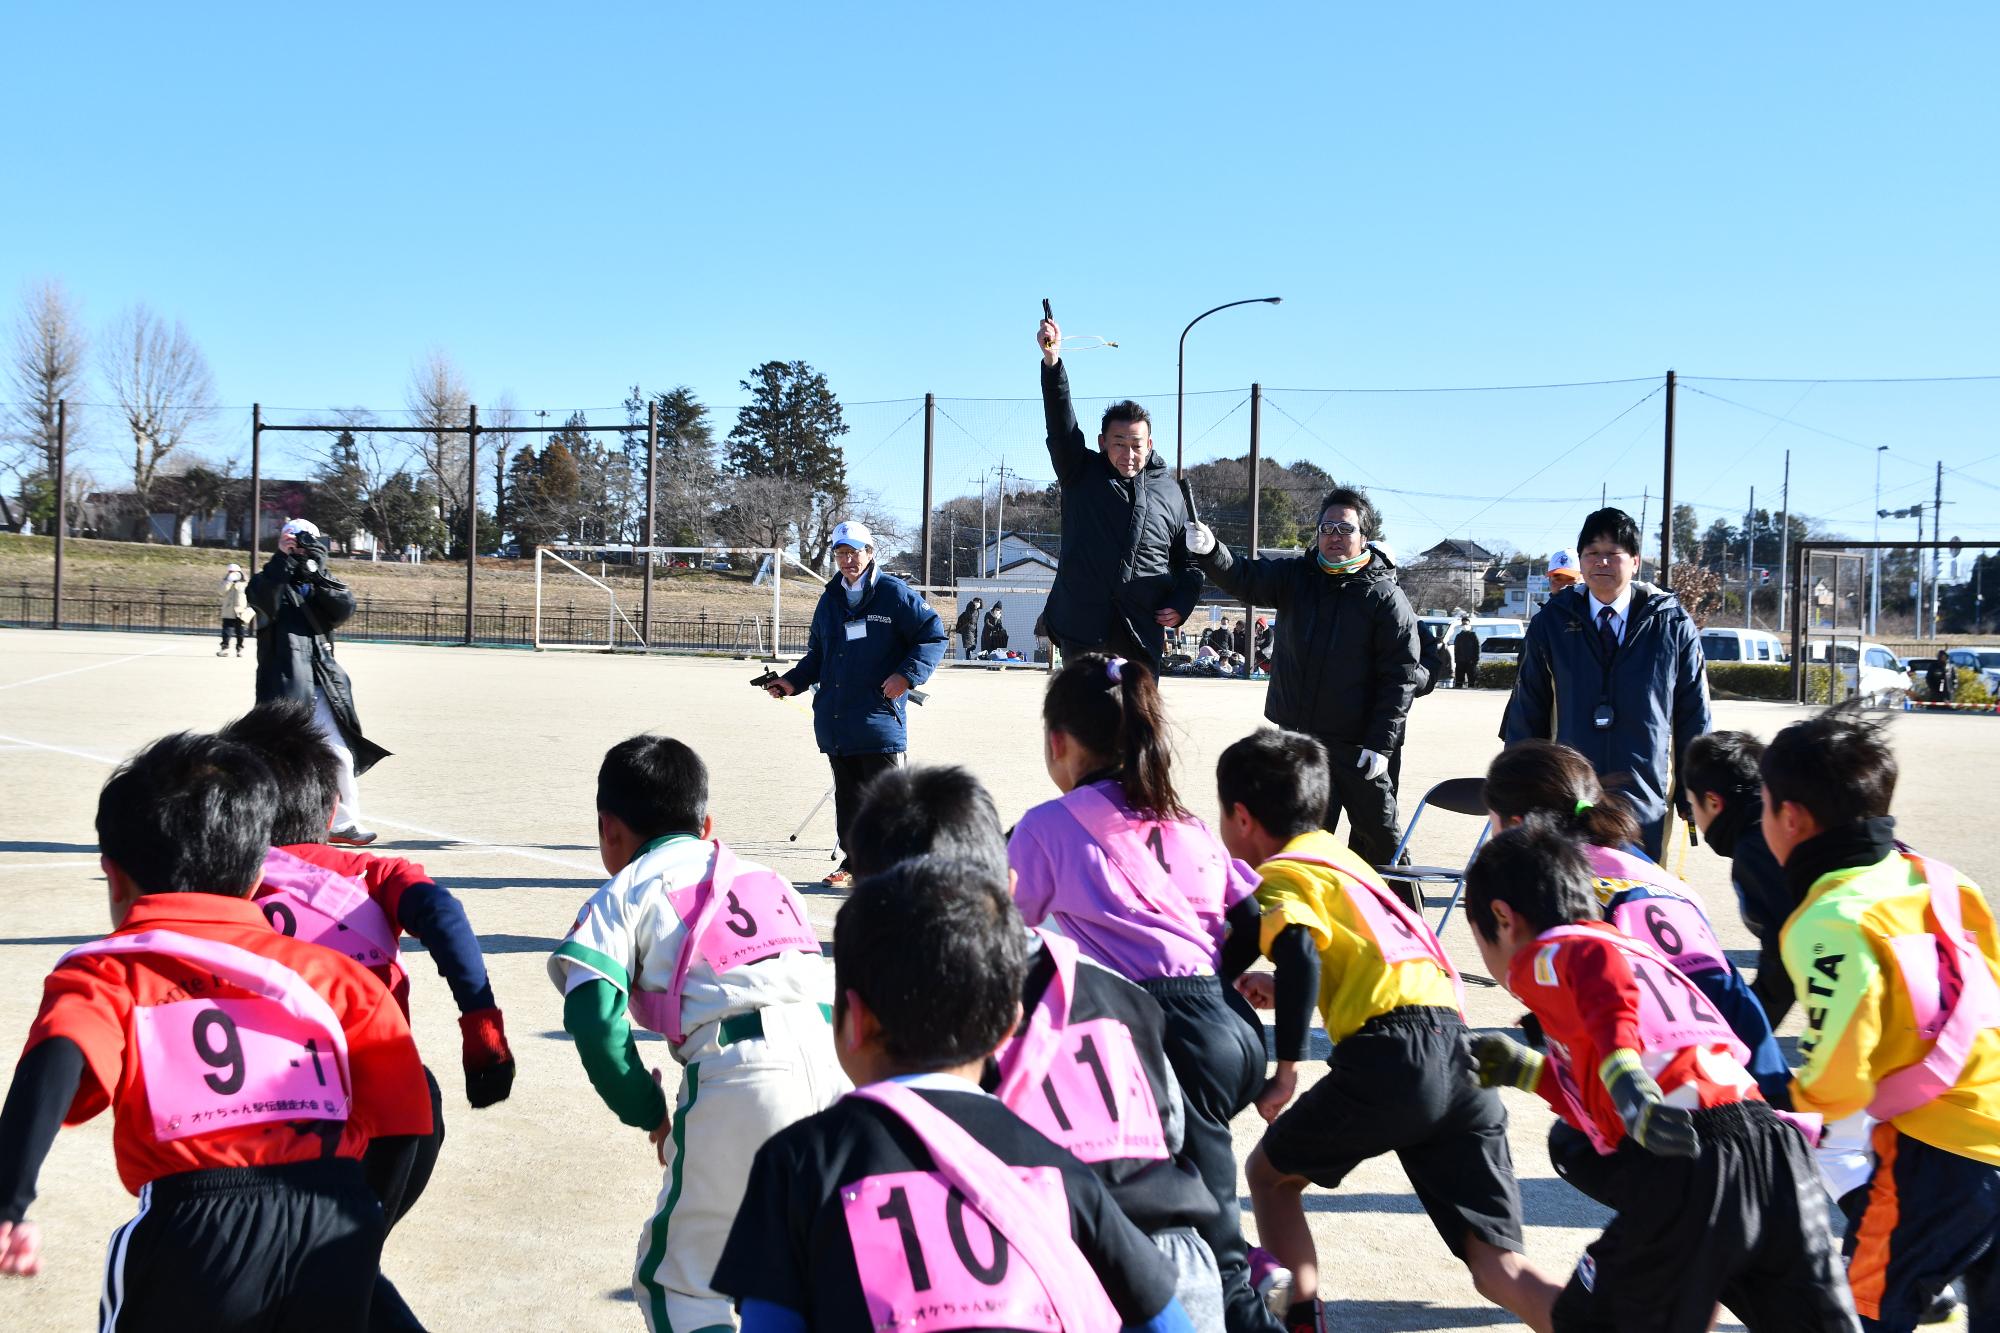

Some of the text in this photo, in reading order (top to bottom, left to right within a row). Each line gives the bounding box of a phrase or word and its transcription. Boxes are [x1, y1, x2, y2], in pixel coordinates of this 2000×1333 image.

[726, 890, 757, 938] 3
[1645, 905, 1683, 956] 6
[1632, 963, 1720, 1025] 12
[193, 1008, 245, 1095] 9
[1041, 1034, 1119, 1131] 11
[877, 1186, 1008, 1292] 10
